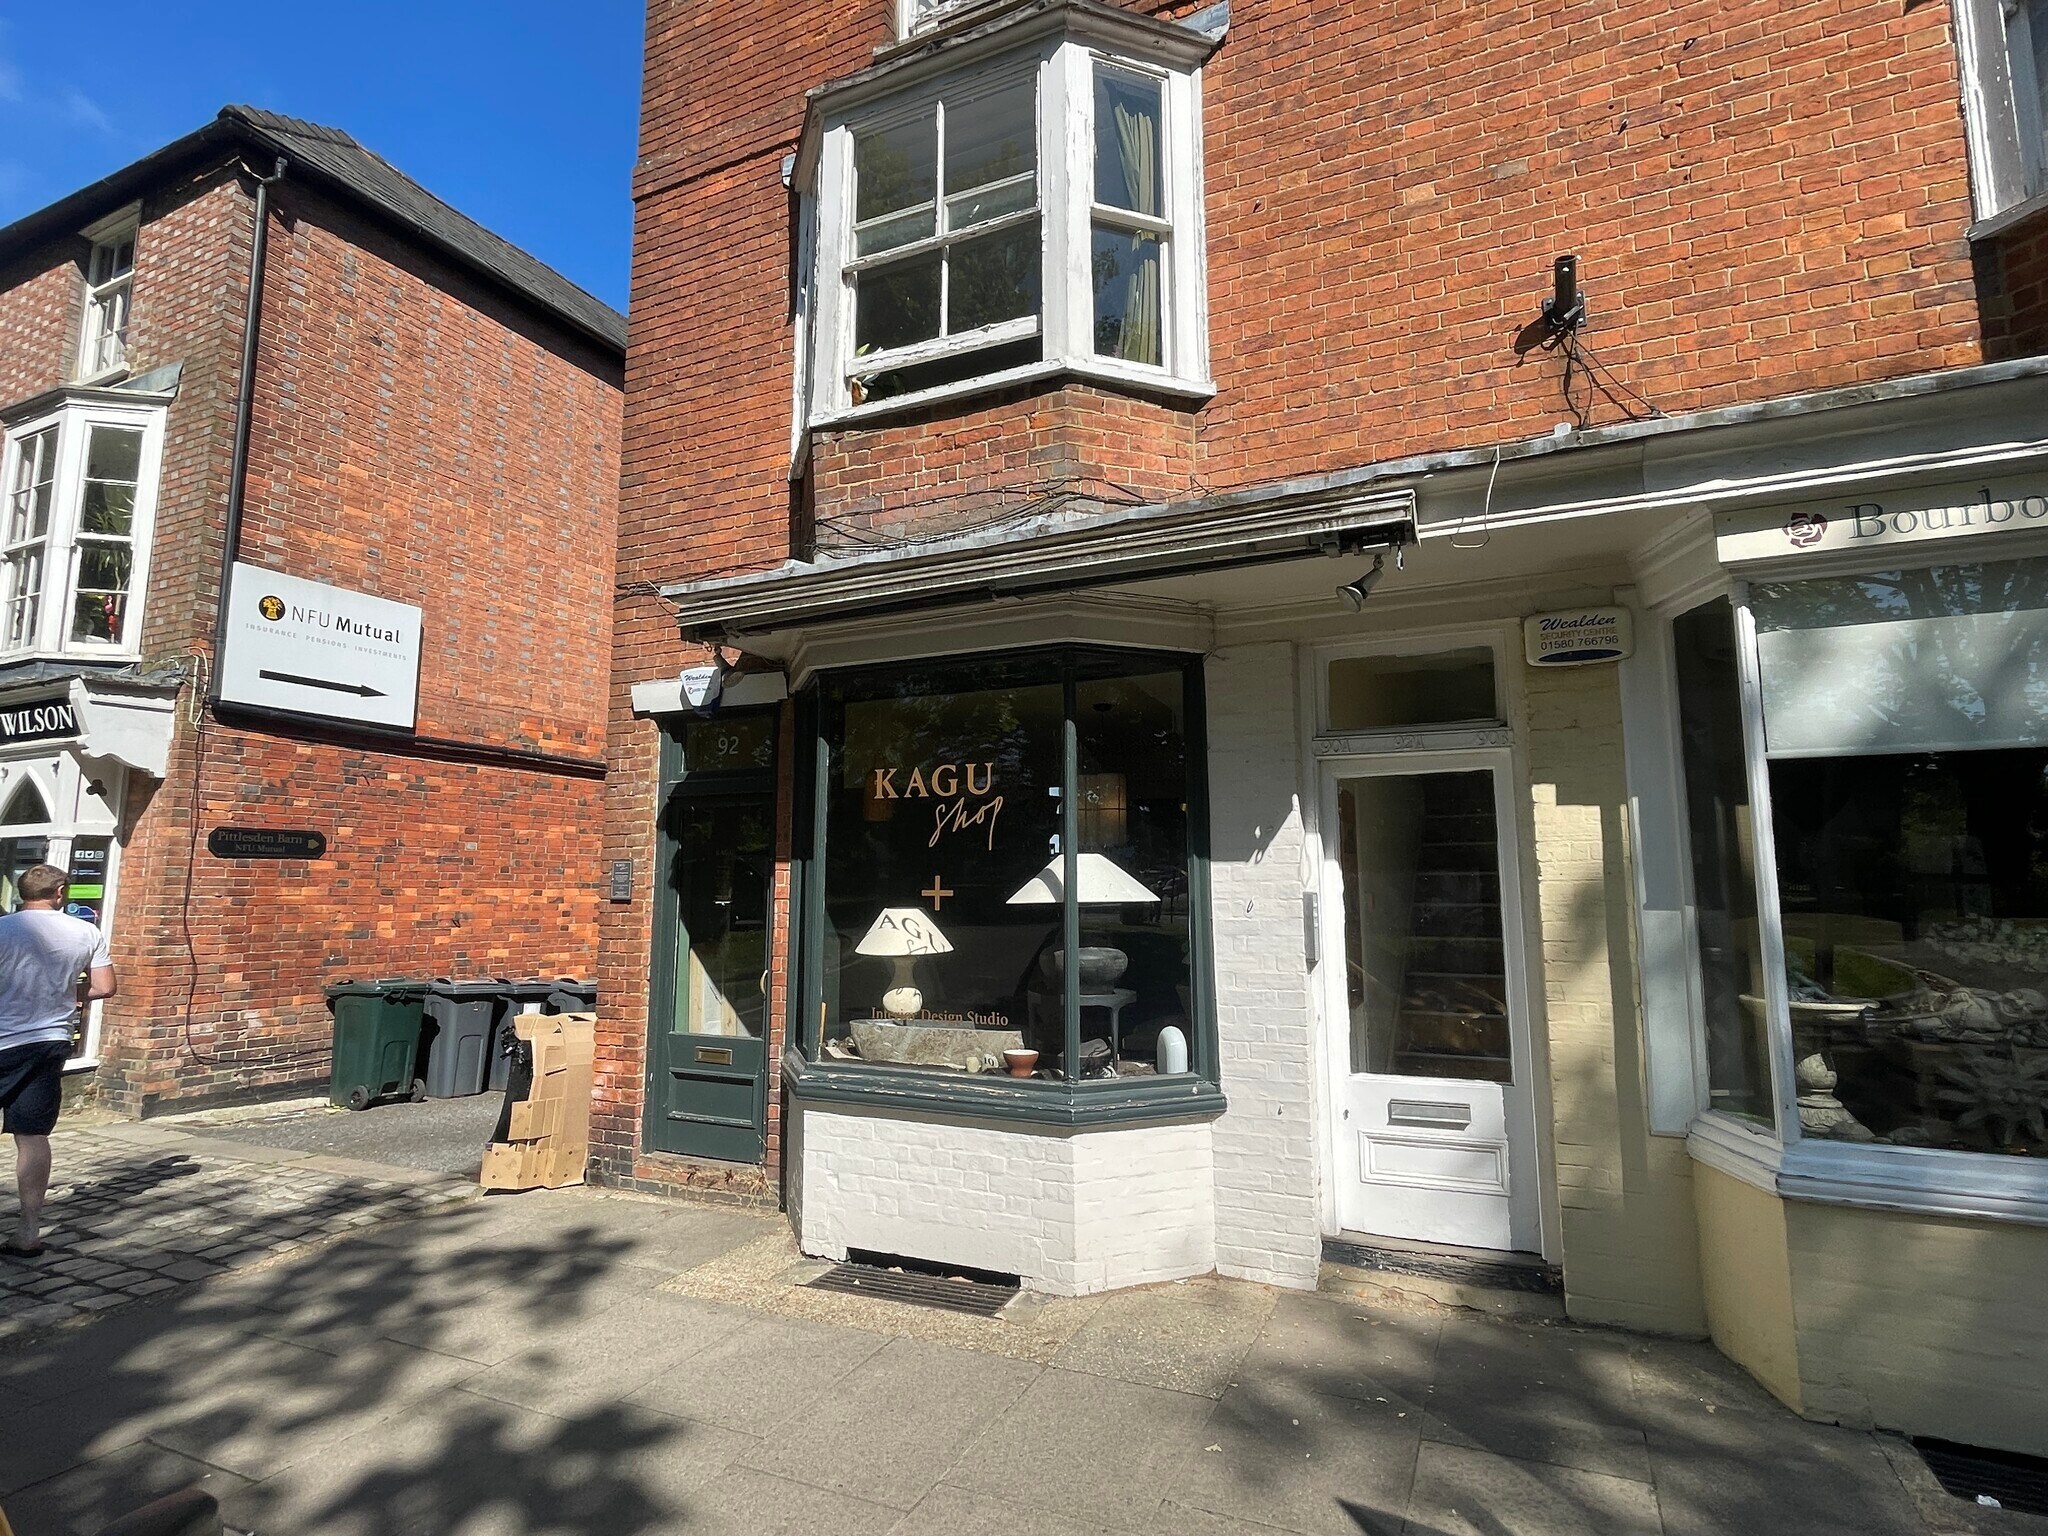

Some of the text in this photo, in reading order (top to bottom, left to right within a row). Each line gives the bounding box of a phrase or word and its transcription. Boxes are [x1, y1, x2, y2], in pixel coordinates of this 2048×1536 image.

[1847, 486, 2048, 540] Bourbo
[291, 606, 400, 644] NFU Mutual
[1539, 614, 1616, 631] Wealden
[245, 623, 407, 661] INSURANCE PENSIONS INVESTMENTS
[1540, 626, 1617, 641] SECURITY CENTRE
[1540, 635, 1619, 651] 01580 766796
[0, 704, 75, 736] WILSON
[718, 735, 739, 755] 92
[874, 762, 994, 799] KAGU
[218, 831, 303, 844] Pittlesden Barn
[235, 843, 286, 853] NFU Mutual
[921, 1009, 963, 1023] Design
[967, 1010, 1009, 1026] Studio
